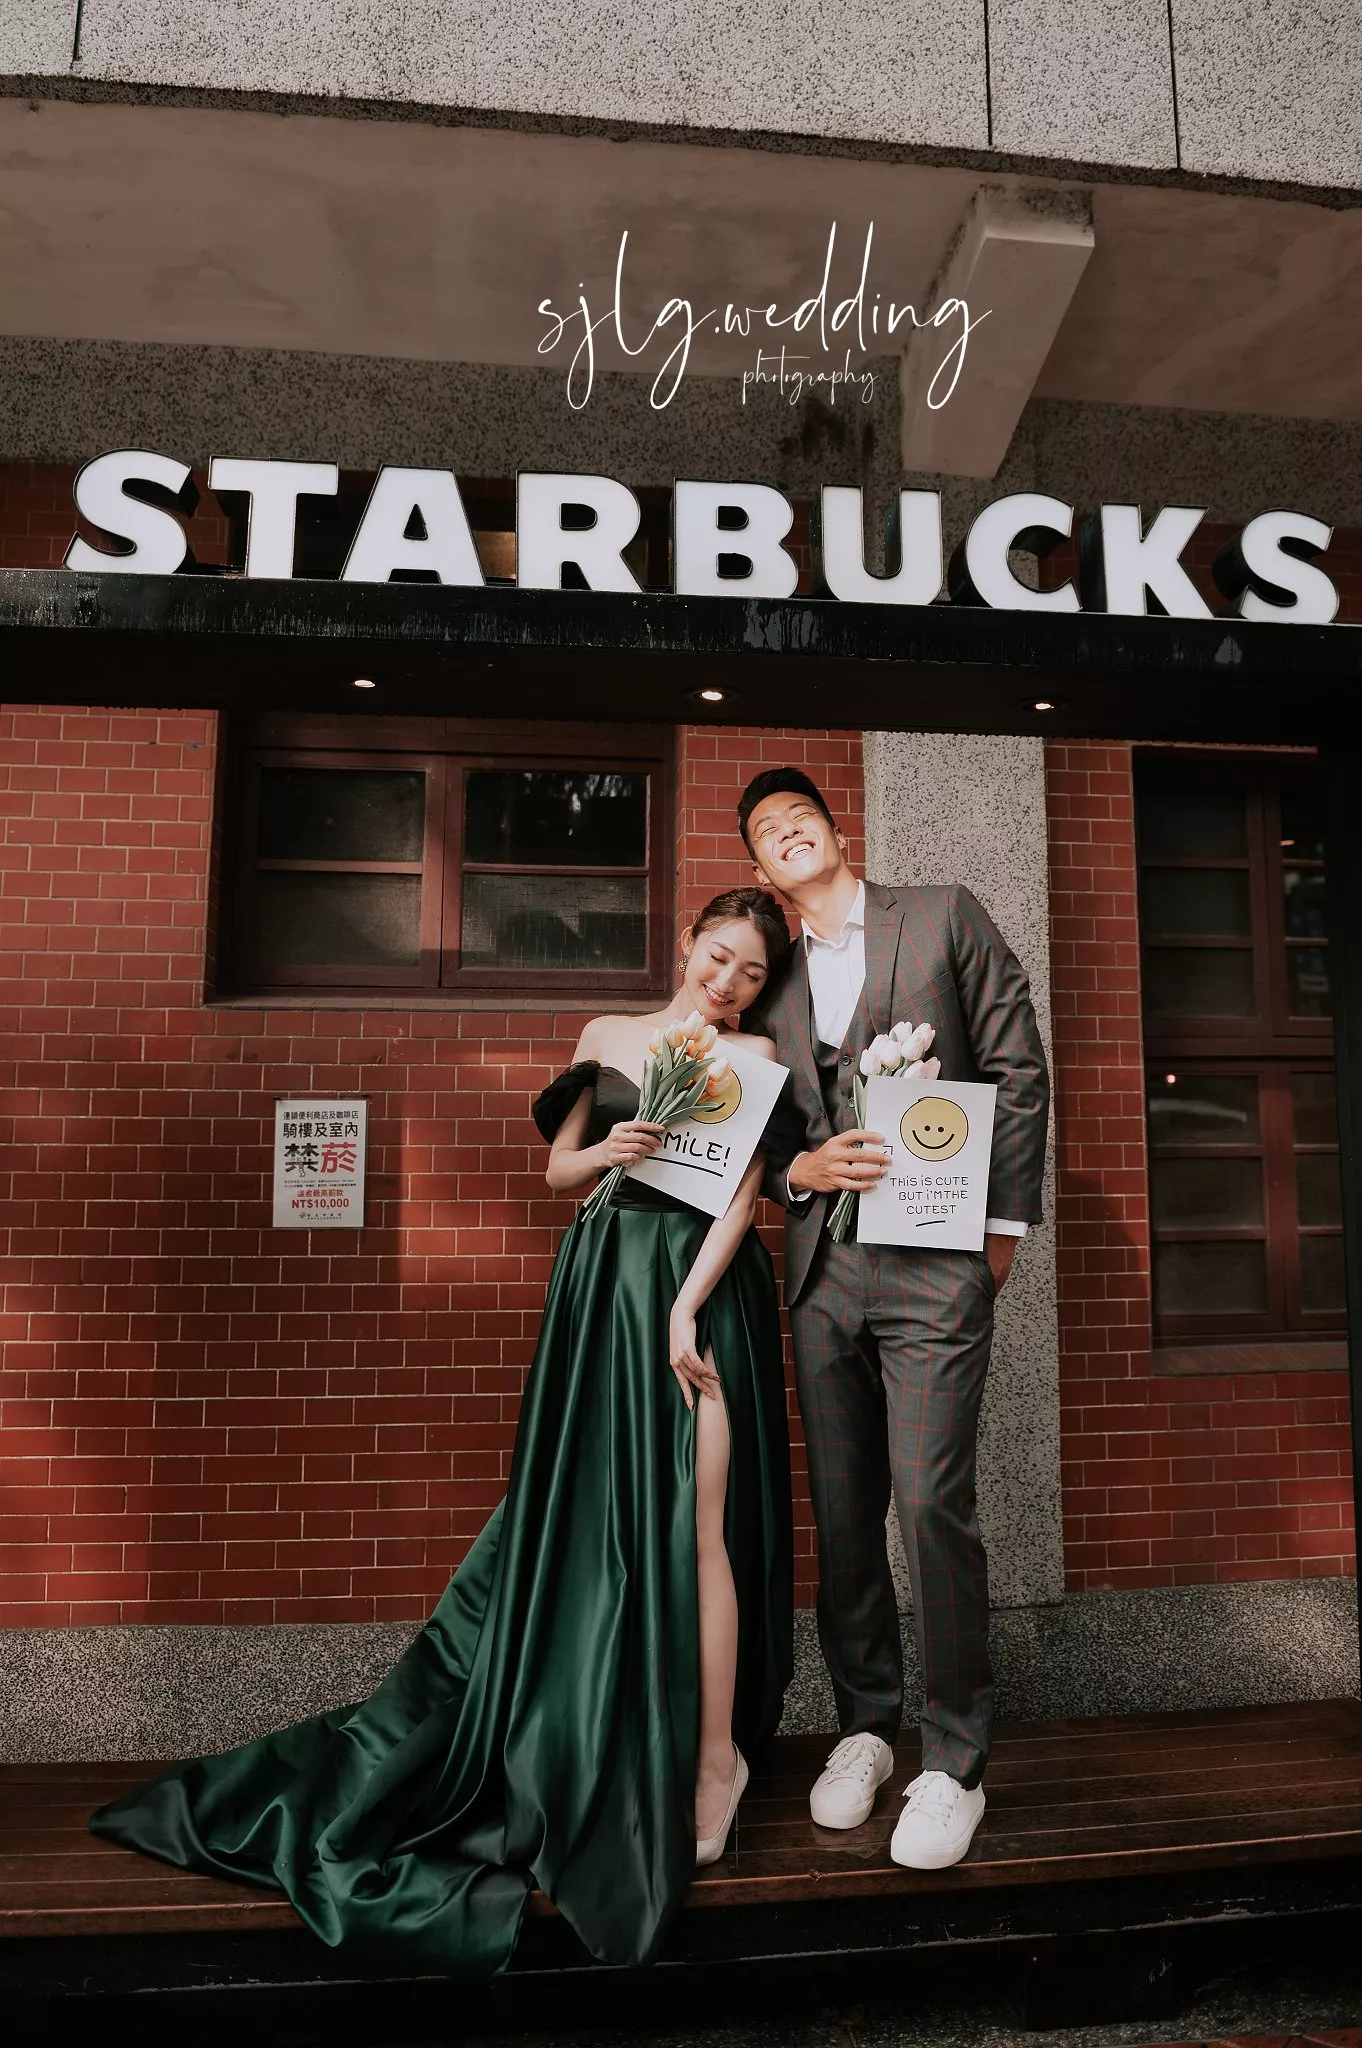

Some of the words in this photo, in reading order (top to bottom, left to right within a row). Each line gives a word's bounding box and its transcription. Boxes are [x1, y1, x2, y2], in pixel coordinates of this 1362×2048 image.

[62, 448, 1340, 624] STARBUCKS
[283, 1122, 358, 1138] 騎樓及室內
[284, 1142, 358, 1173] 禁菸
[935, 1176, 969, 1186] CUTE
[898, 1191, 923, 1201] BUT
[292, 1199, 349, 1209] NT$10,000
[906, 1204, 957, 1215] CUTEST
